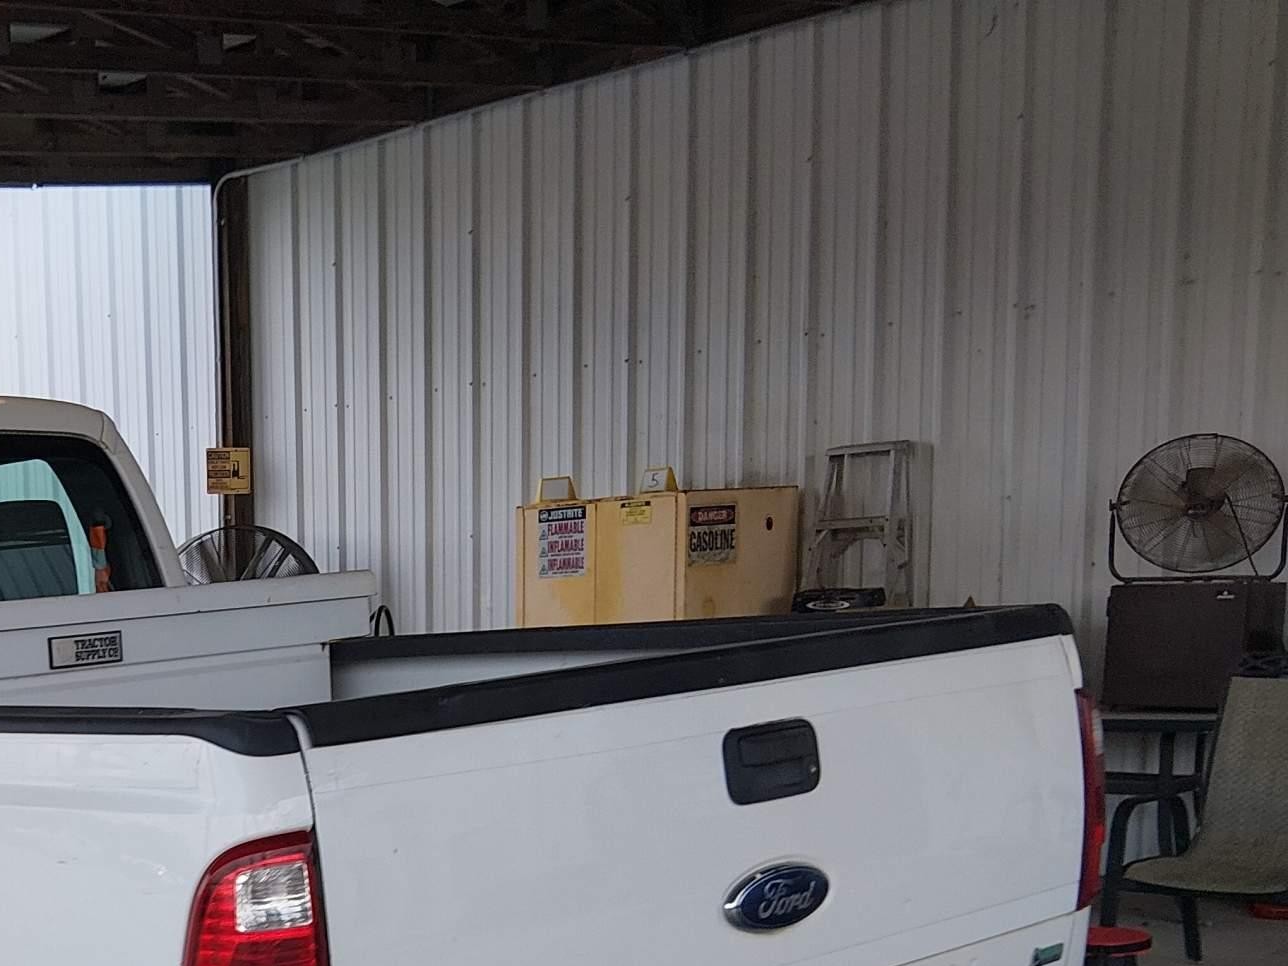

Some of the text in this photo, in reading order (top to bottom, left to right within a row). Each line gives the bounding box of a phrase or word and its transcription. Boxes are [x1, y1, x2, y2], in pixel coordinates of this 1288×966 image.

[648, 472, 660, 489] 5
[697, 510, 728, 521] DANGER
[547, 520, 585, 537] FLAMMABLE
[690, 528, 736, 552] GASOLINE
[74, 636, 117, 650] TRACTOR
[758, 879, 817, 919] Ford
